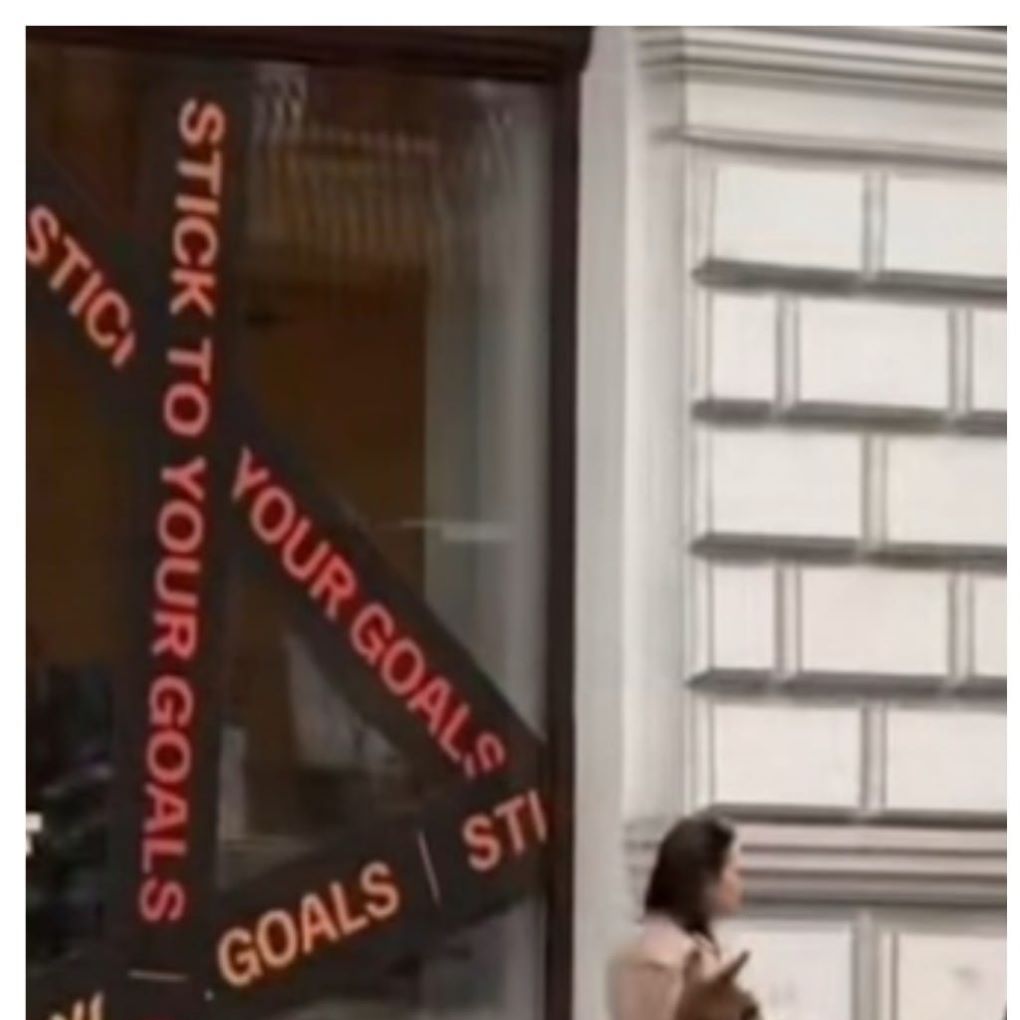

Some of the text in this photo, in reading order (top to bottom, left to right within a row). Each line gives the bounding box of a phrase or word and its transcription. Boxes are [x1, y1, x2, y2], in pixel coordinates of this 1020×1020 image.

[169, 98, 226, 317] STICK
[163, 338, 212, 437] TO
[152, 456, 206, 661] YOUR
[232, 446, 357, 620] YOUR
[139, 674, 194, 923] GOALS
[216, 861, 400, 986] GOALS
